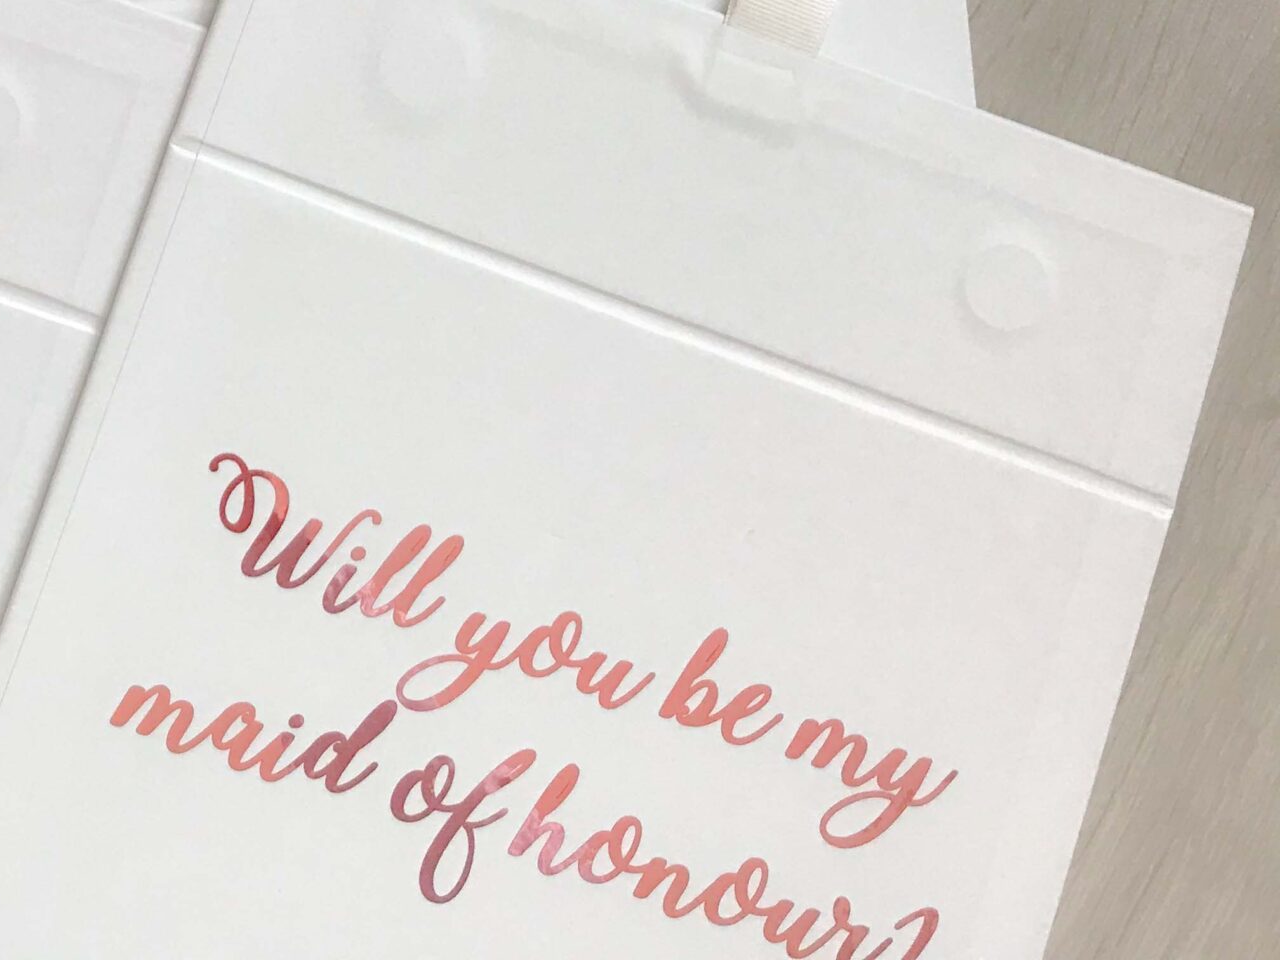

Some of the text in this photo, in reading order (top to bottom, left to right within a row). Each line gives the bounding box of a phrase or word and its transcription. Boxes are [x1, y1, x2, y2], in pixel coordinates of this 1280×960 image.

[110, 684, 397, 793] maid
[390, 748, 537, 903] of
[209, 452, 957, 849] Will you be my
